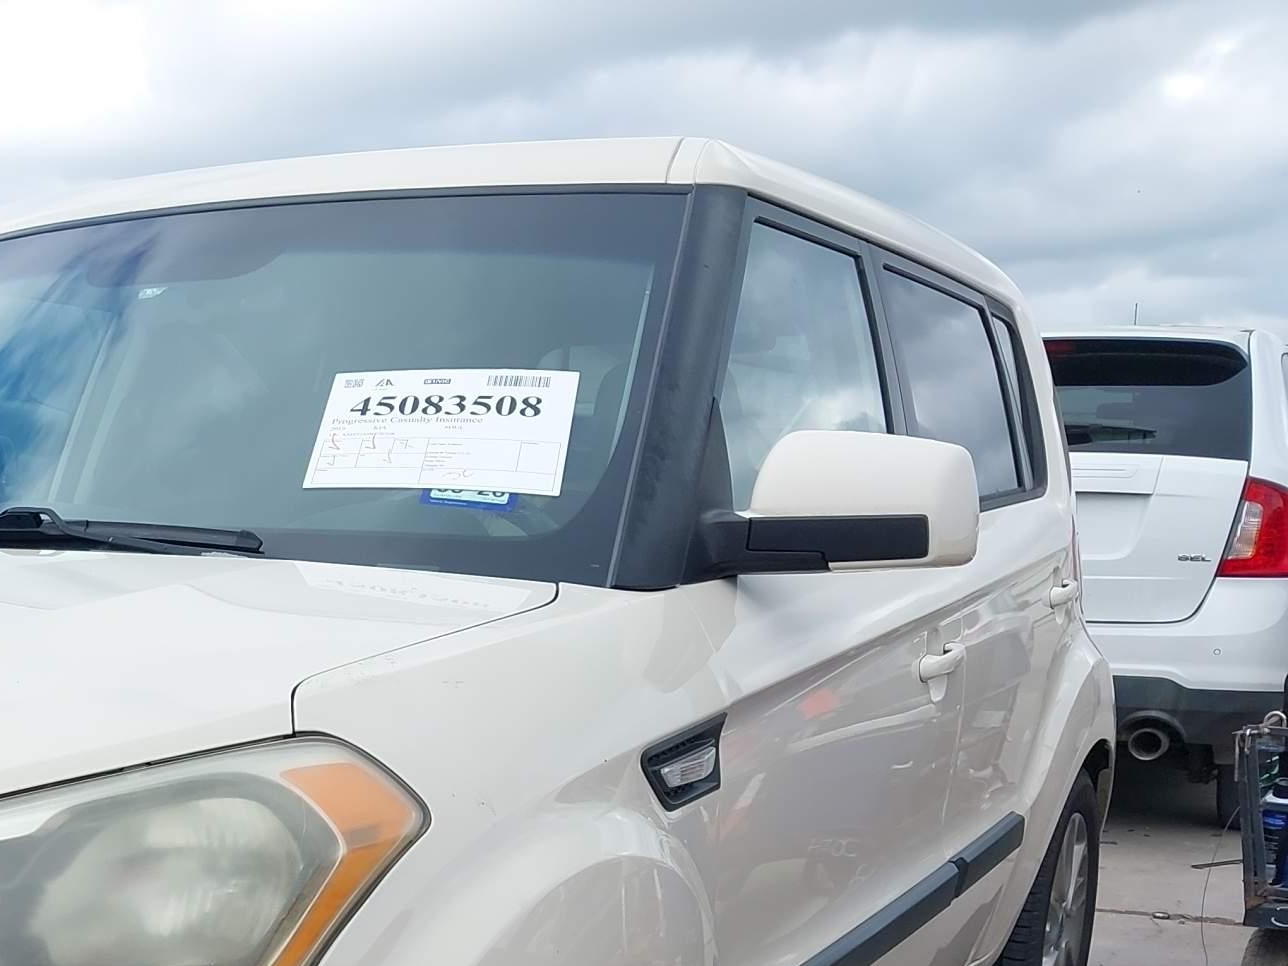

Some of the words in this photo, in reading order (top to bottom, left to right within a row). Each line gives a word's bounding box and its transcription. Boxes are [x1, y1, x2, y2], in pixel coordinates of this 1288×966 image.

[350, 394, 543, 418] 45083508
[331, 416, 387, 426] Progressive
[390, 415, 433, 424] Casualty
[436, 415, 484, 423] Insurance
[1178, 553, 1211, 562] SEL
